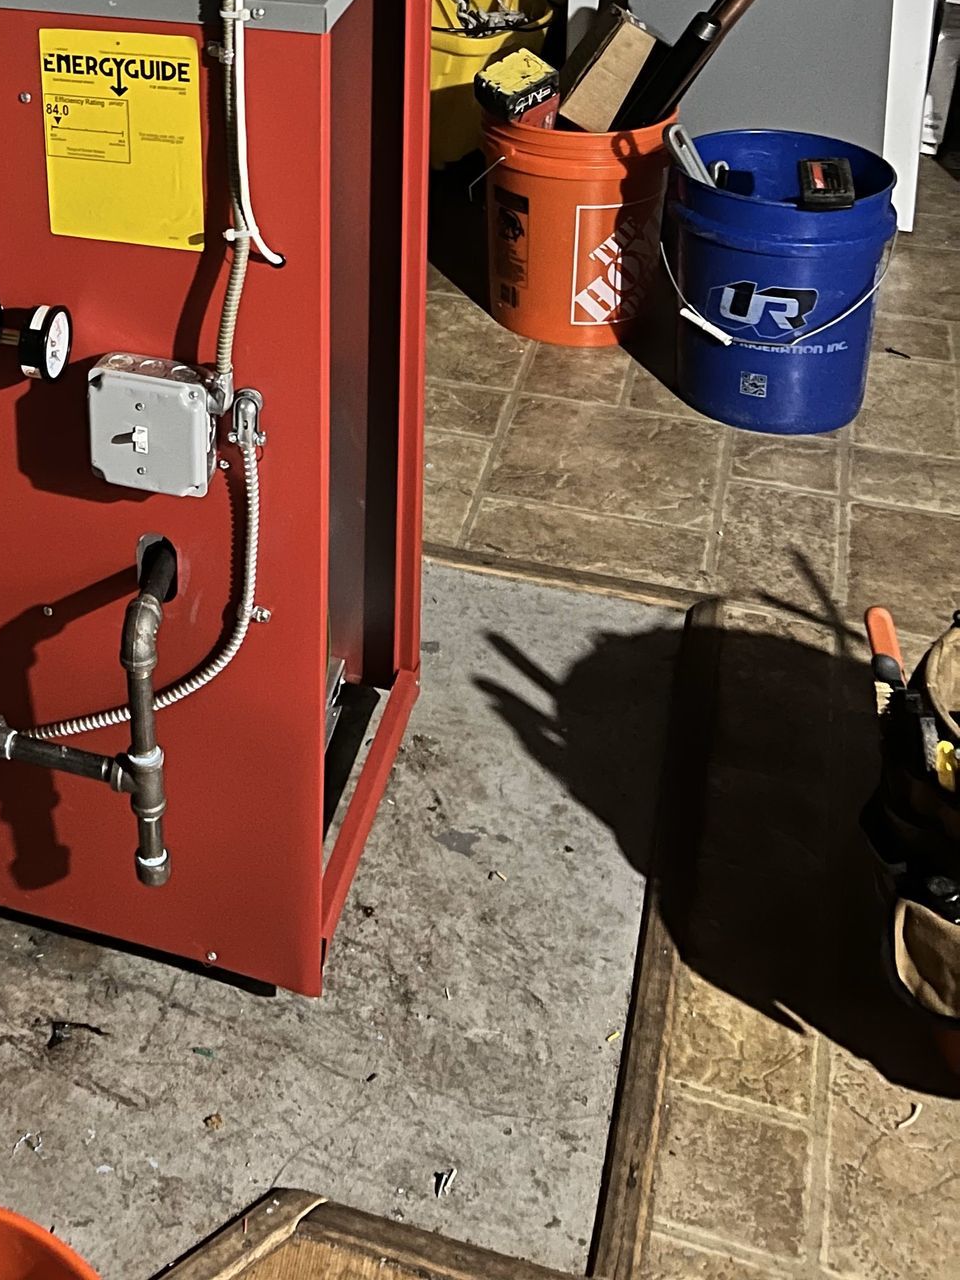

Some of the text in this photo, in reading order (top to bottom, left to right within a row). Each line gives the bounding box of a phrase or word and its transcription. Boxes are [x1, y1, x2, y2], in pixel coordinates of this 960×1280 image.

[43, 53, 190, 83] ENERGYGUIDE
[54, 96, 84, 106] Efficiency
[85, 98, 105, 108] Rating
[45, 103, 69, 116] 84.0
[826, 340, 849, 354] INC
